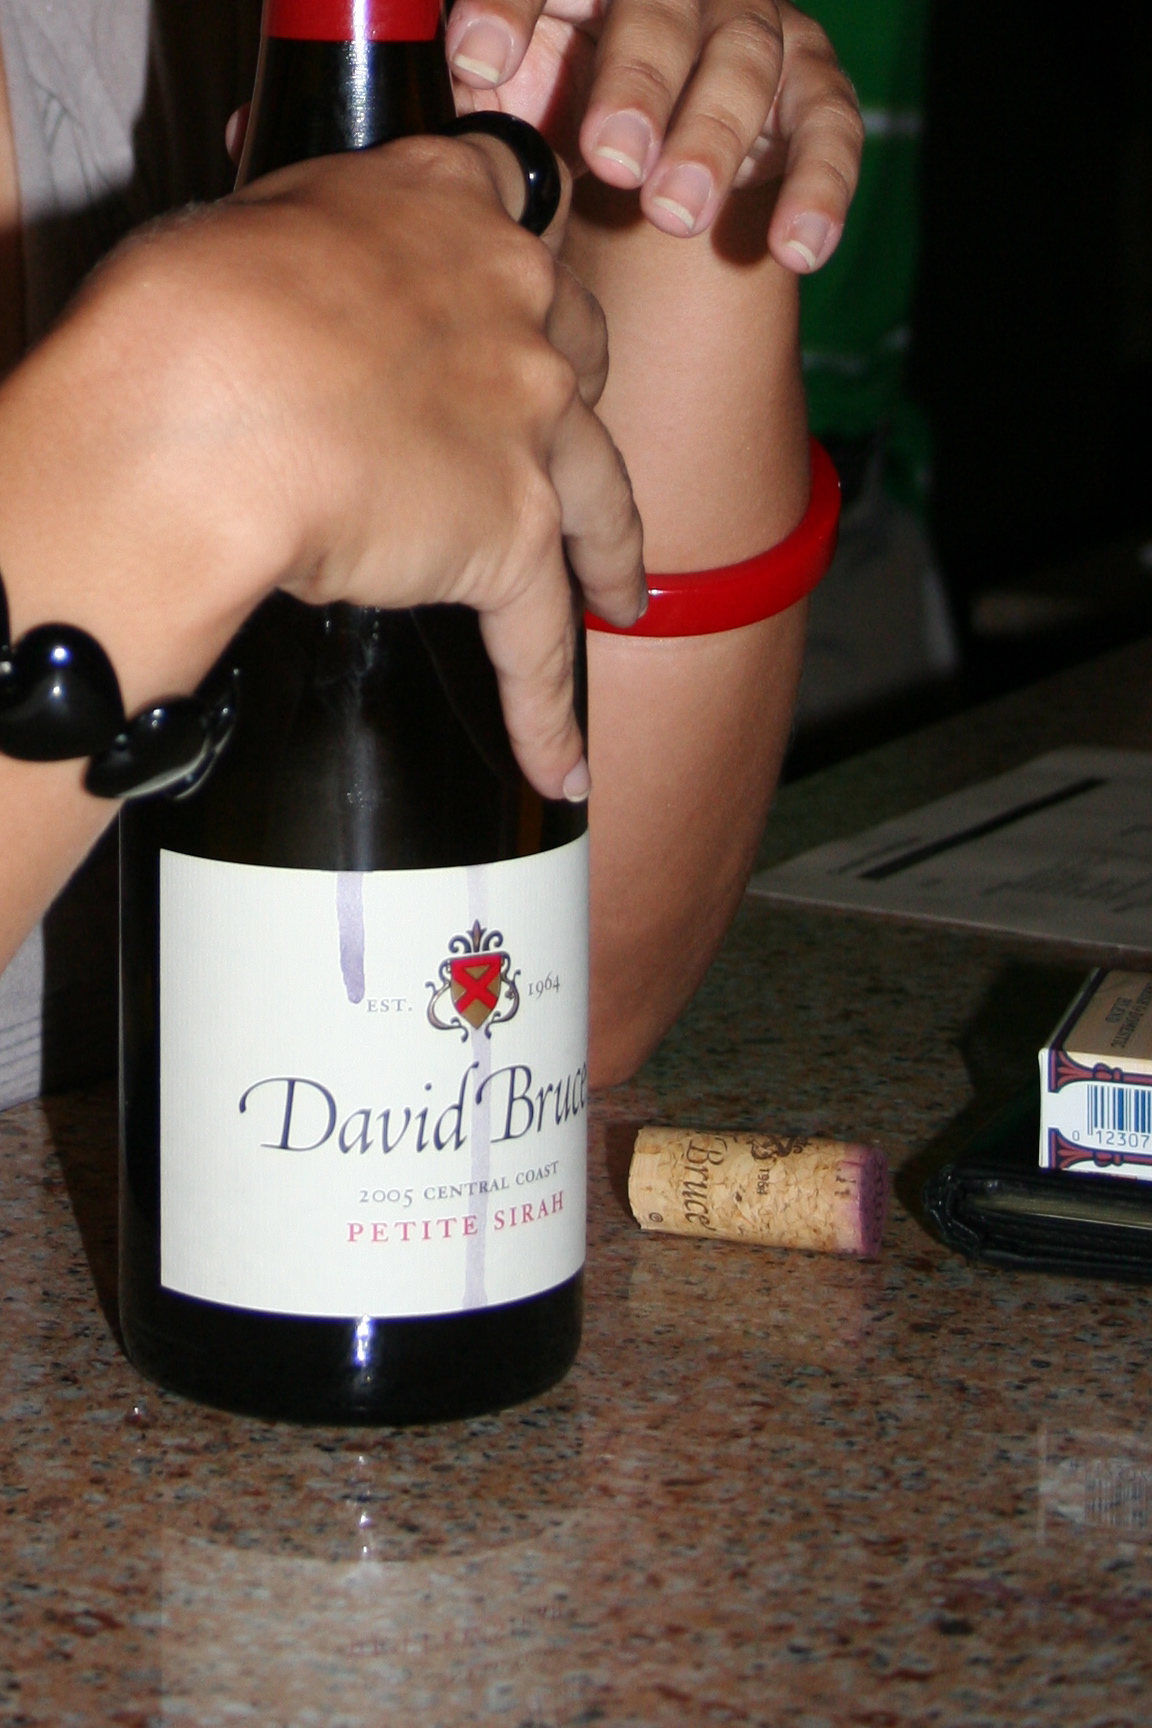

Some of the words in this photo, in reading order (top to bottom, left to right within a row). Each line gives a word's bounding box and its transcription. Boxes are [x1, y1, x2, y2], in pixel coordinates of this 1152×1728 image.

[366, 998, 413, 1013] EST.
[528, 974, 561, 999] 1964
[238, 1060, 480, 1154] David
[1071, 1129, 1081, 1142] 0
[1096, 1130, 1150, 1149] 12307
[359, 1188, 414, 1208] 2005
[423, 1176, 510, 1201] CENTRAL
[515, 1160, 560, 1186] COAST
[683, 1136, 728, 1232] Bruce
[755, 1167, 770, 1196] 1964
[347, 1215, 479, 1242] PETITE
[493, 1190, 565, 1231] SIRAH
